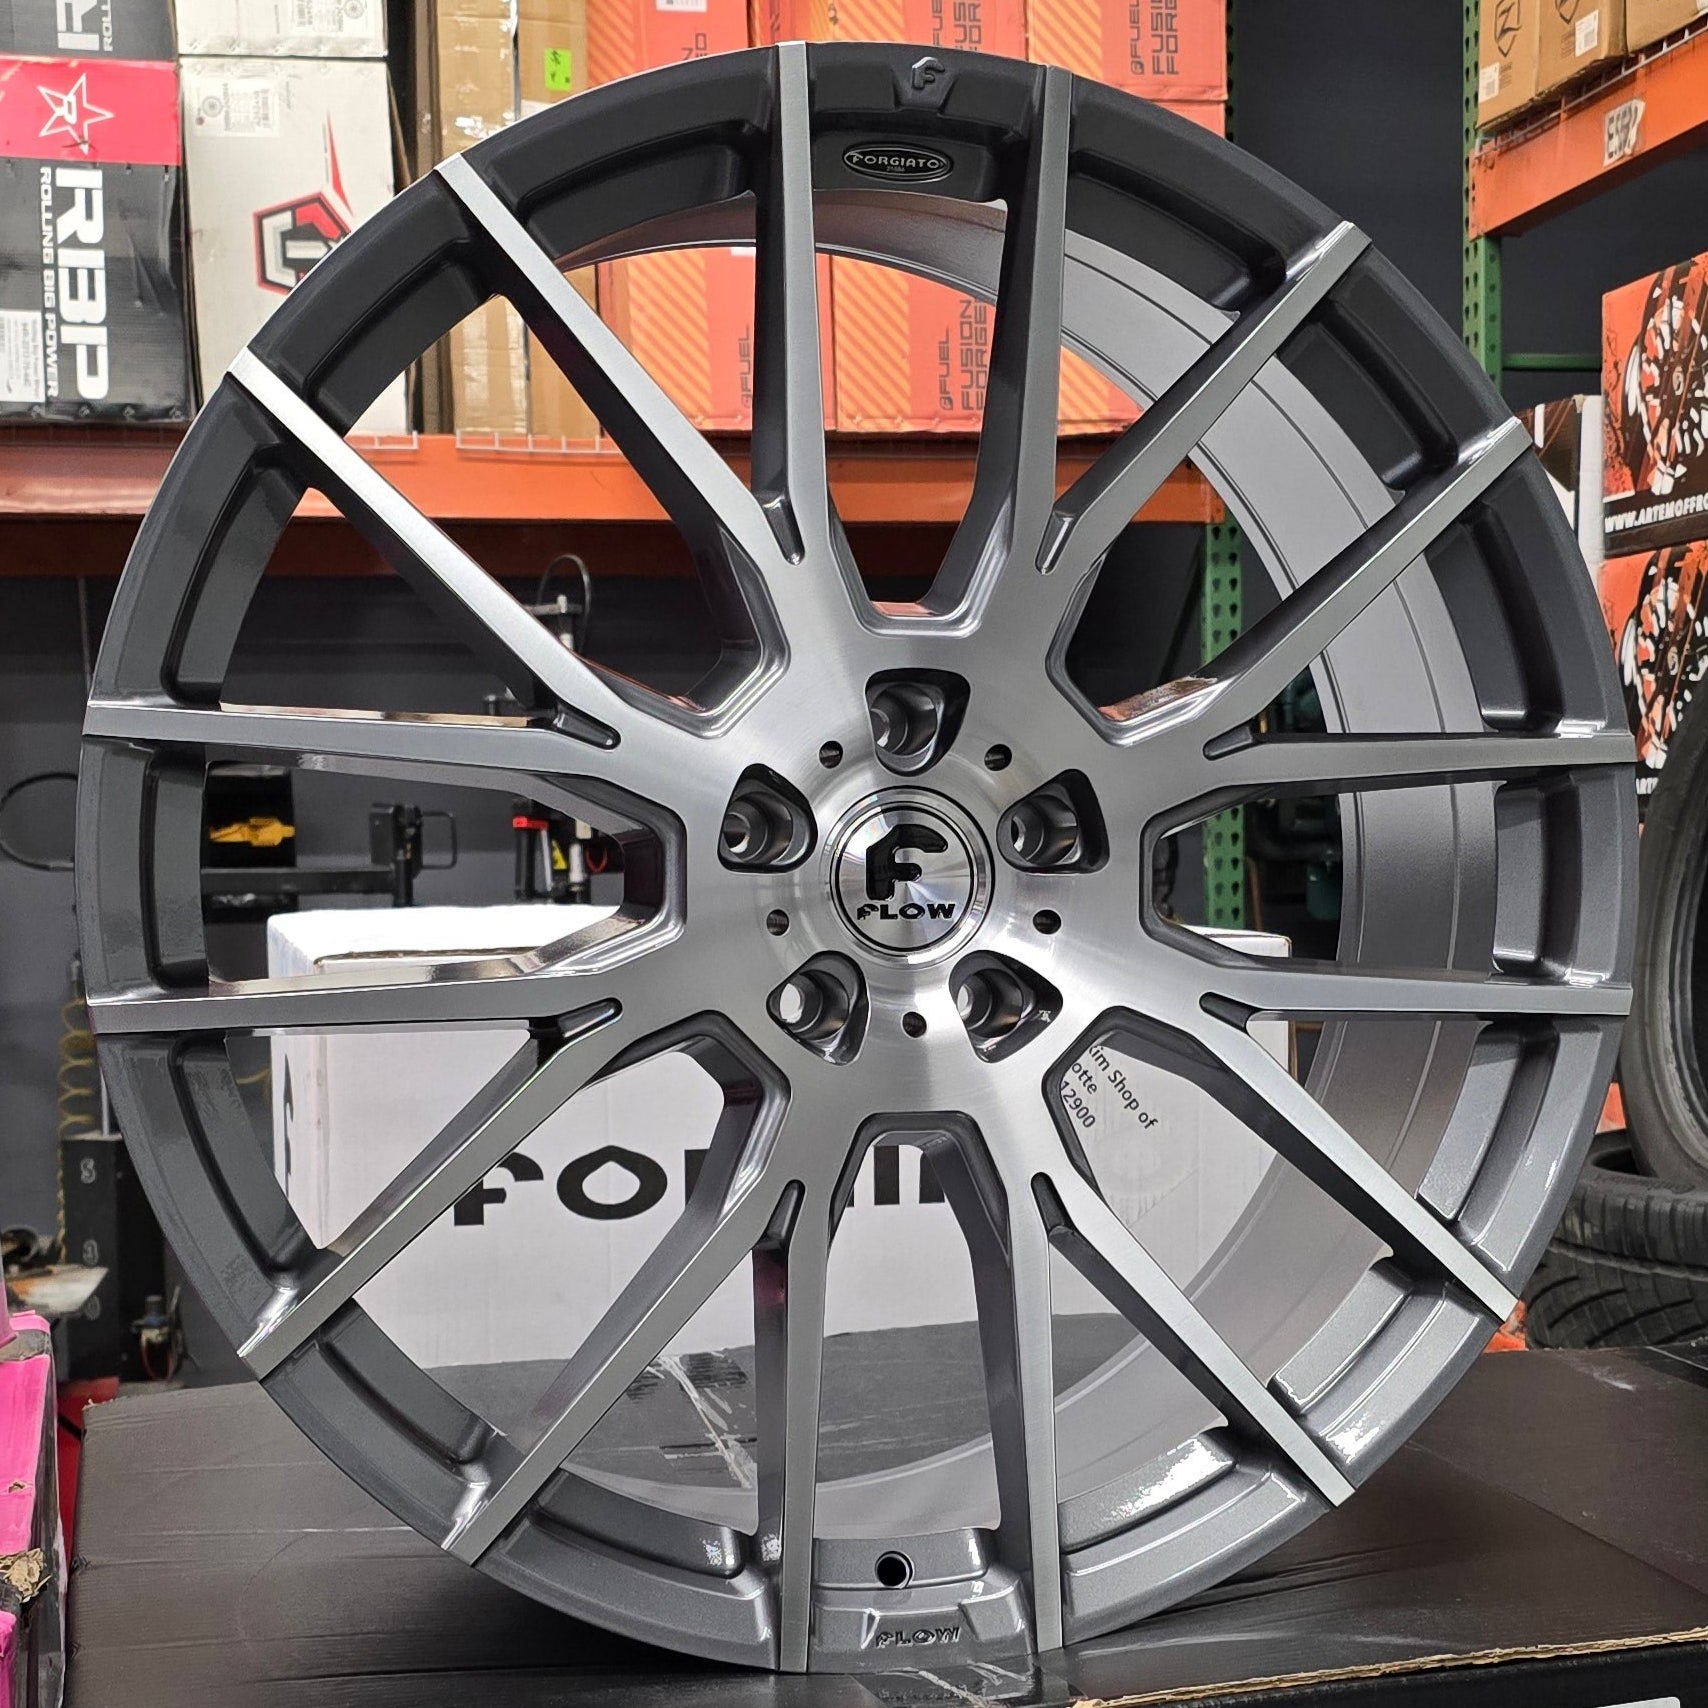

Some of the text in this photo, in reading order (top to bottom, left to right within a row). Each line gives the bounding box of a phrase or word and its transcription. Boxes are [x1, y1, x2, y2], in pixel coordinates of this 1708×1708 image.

[848, 152, 940, 169] FORGIATO
[40, 166, 59, 397] ROLLING BIG POWER
[55, 167, 109, 400] RBP
[938, 325, 950, 395] FUEL
[959, 299, 973, 411] FUSION
[856, 902, 956, 921] FLOW
[1060, 1080, 1096, 1128] 12900
[1107, 1069, 1140, 1111] Shop
[1137, 1112, 1159, 1130] of
[875, 1625, 961, 1649] FLOW
